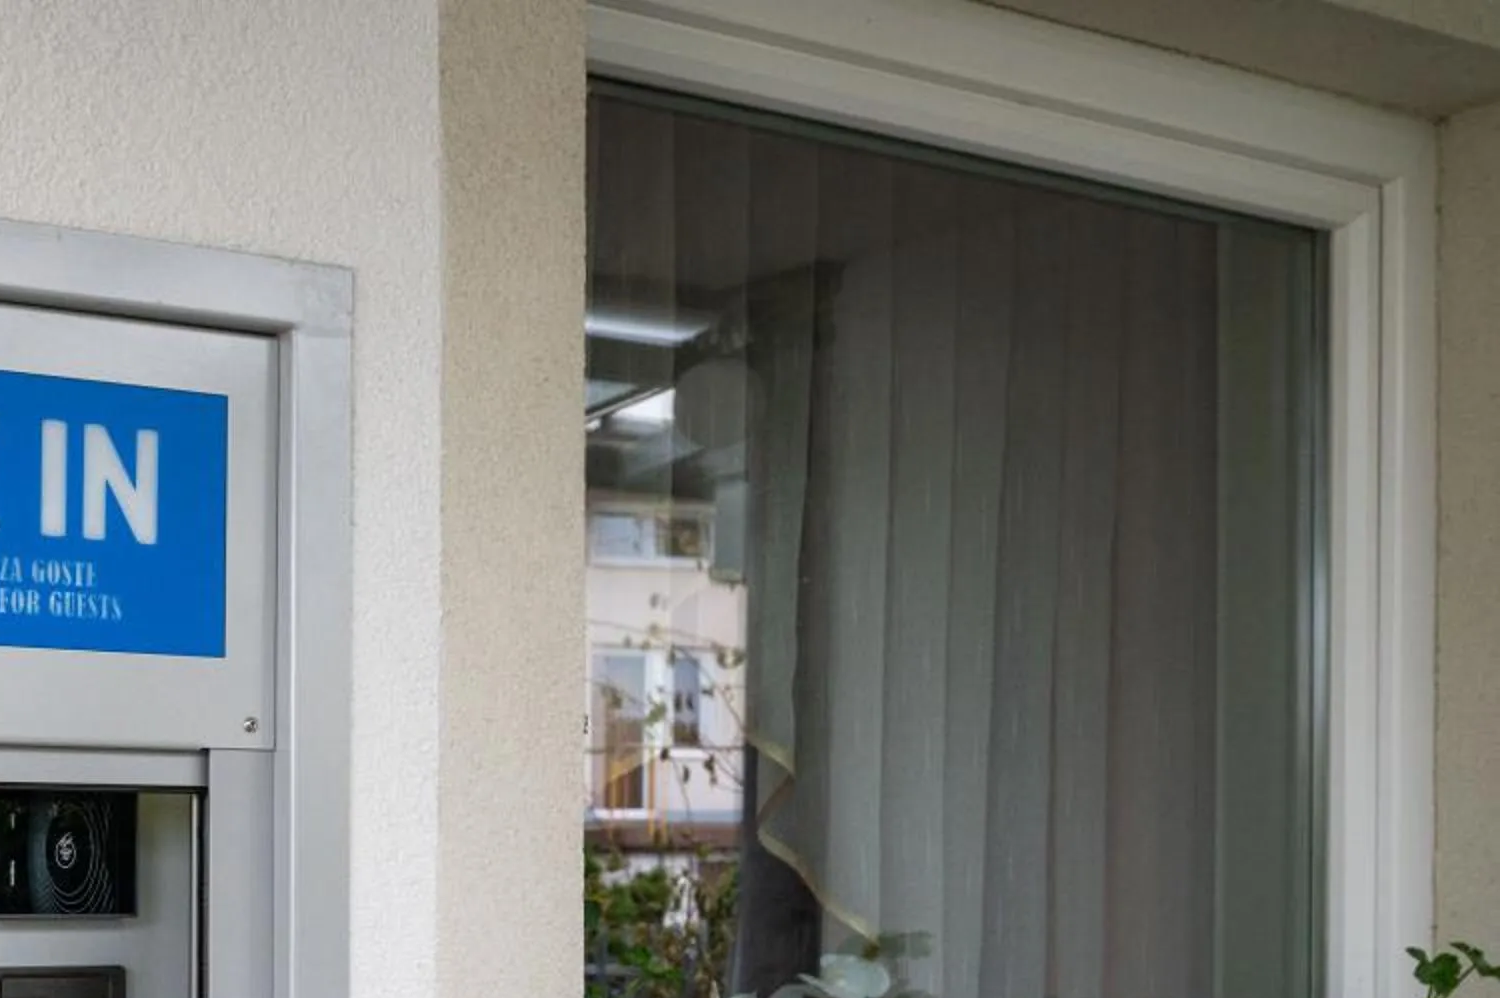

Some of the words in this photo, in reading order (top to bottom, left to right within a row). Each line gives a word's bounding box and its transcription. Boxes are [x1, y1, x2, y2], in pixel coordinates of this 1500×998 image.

[40, 419, 159, 545] IN
[0, 556, 22, 583] ZA
[32, 558, 97, 588] GOSTE
[0, 588, 40, 616] FOR
[49, 590, 123, 621] GUESTS
